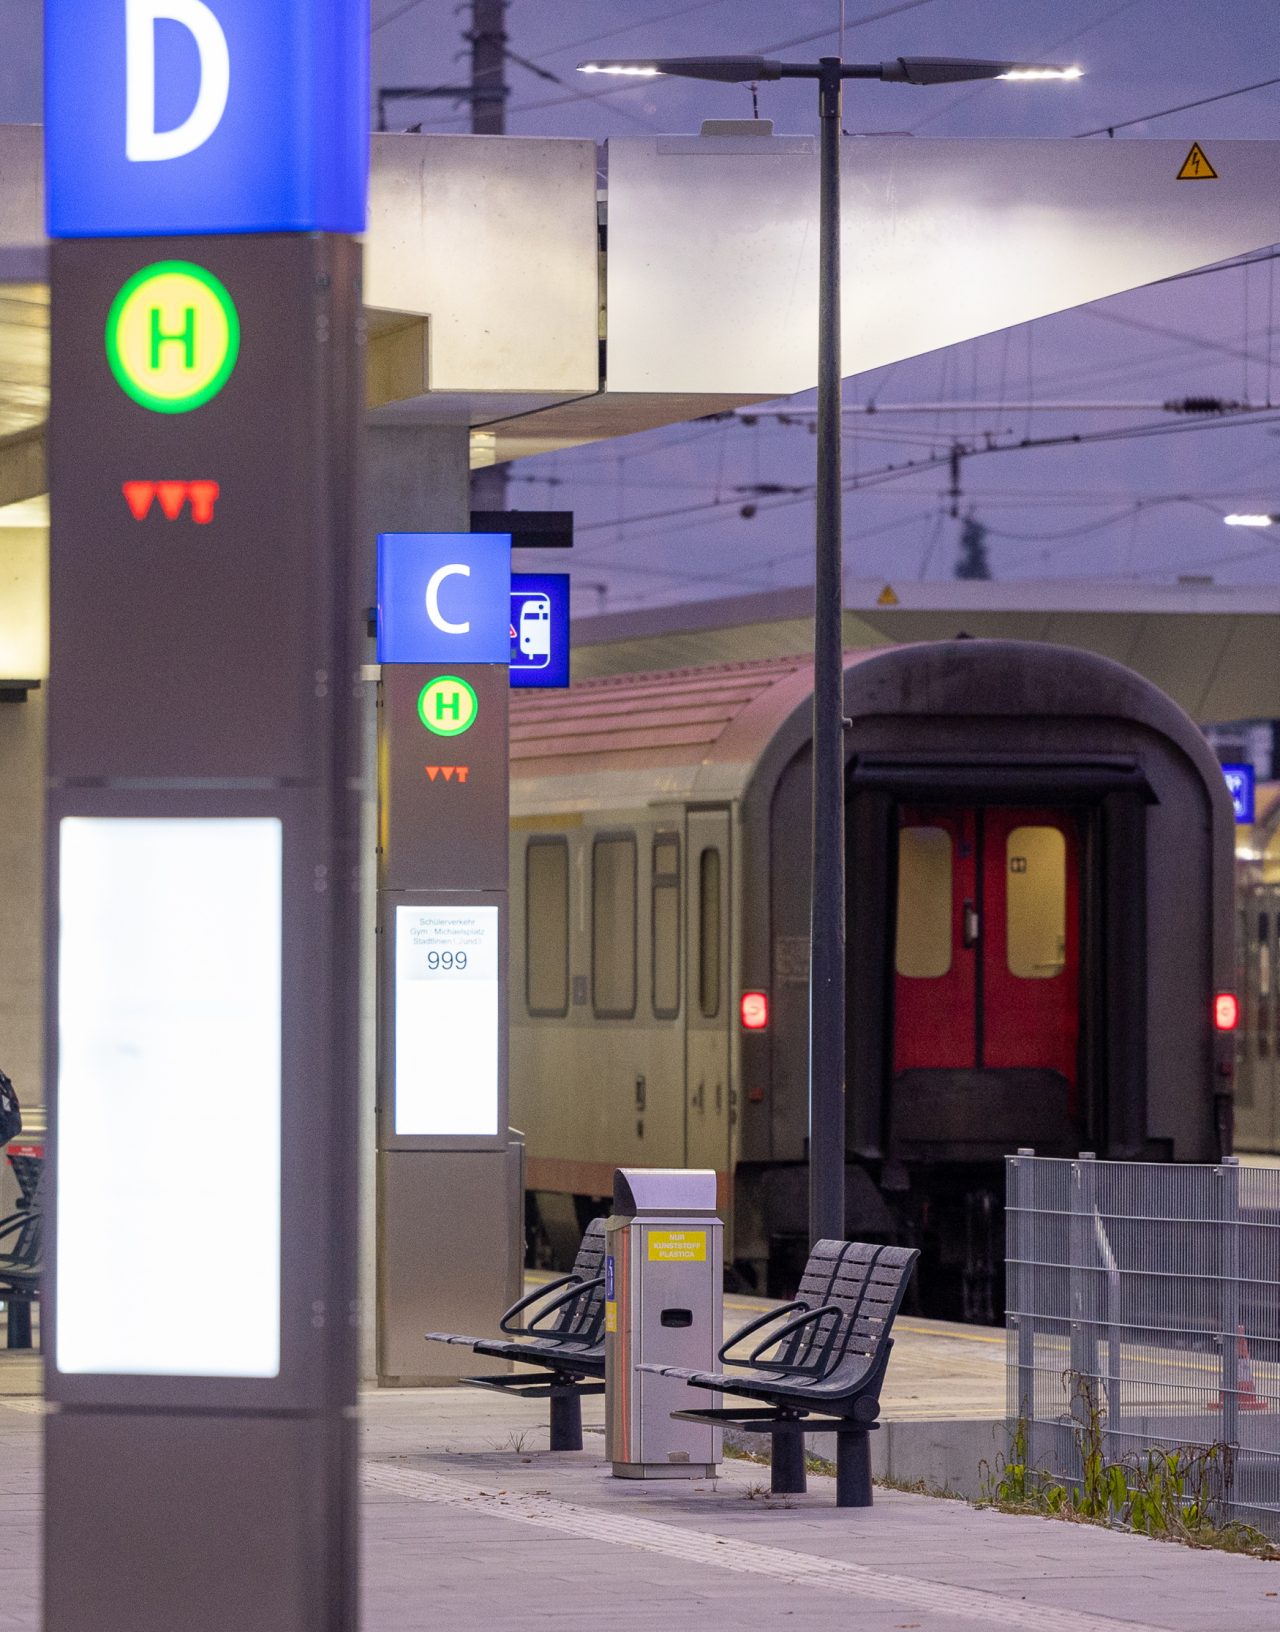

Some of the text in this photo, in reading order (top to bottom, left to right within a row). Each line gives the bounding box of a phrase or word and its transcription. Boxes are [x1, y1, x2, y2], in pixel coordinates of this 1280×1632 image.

[125, 0, 231, 162] D
[150, 307, 195, 370] H
[425, 563, 470, 634] C
[435, 692, 460, 720] H
[427, 951, 468, 970] 999
